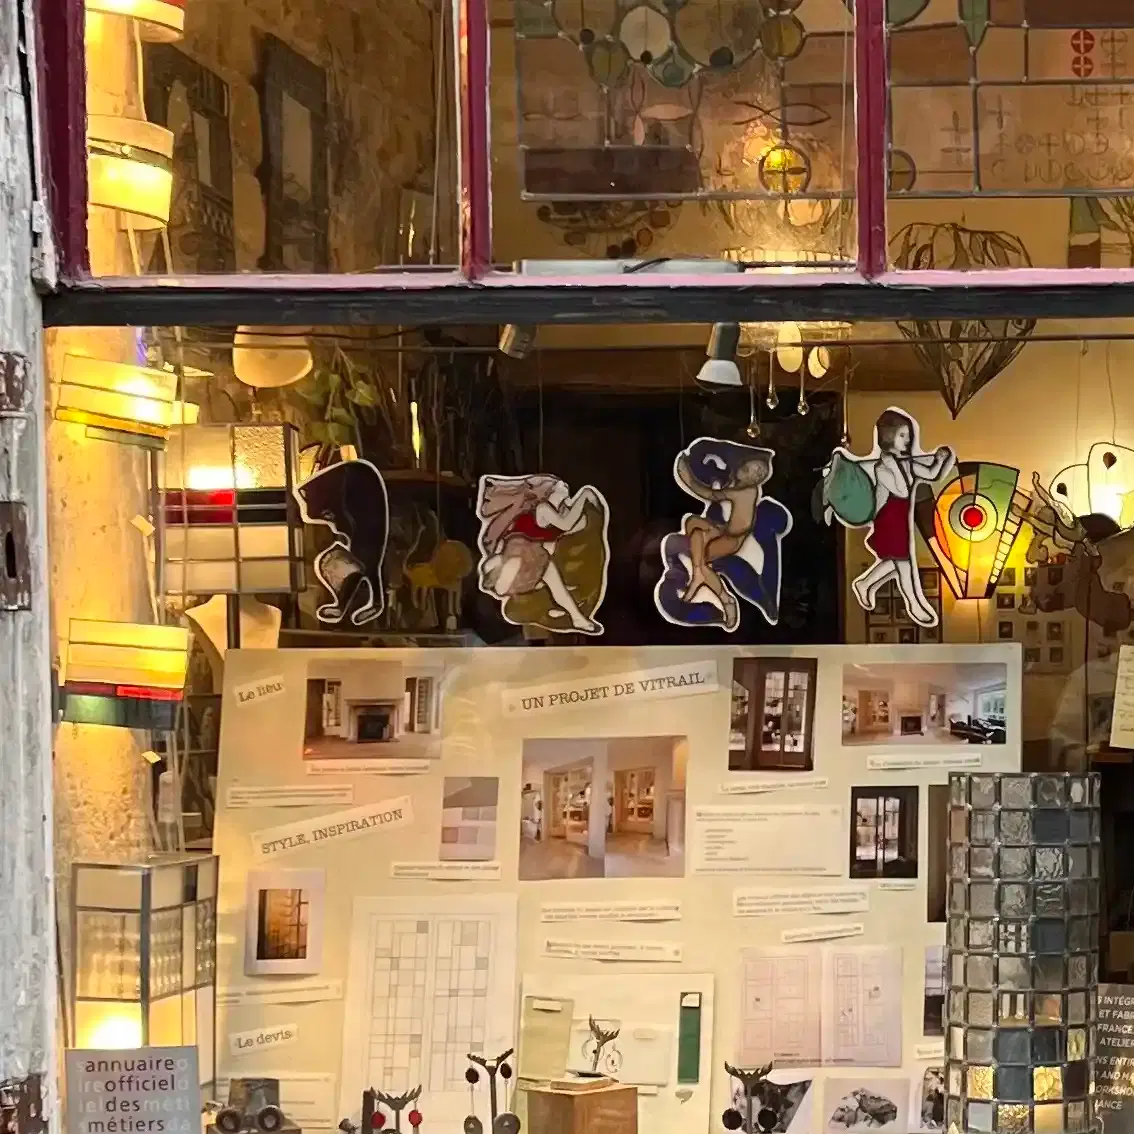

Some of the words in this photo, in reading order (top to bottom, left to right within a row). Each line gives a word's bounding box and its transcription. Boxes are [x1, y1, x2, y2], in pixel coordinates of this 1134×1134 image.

[521, 696, 544, 710] UN
[548, 686, 610, 706] PROJET
[614, 683, 635, 697] DE
[639, 672, 705, 692] VITRAIL
[312, 808, 404, 841] INSPIRATION
[1098, 1008, 1111, 1018] ET
[256, 1029, 293, 1044] devis
[85, 1058, 175, 1073] annuaire
[104, 1074, 175, 1092] officiel
[1100, 1070, 1121, 1080] AND
[106, 1096, 141, 1113] des
[88, 1115, 165, 1133] métiers
